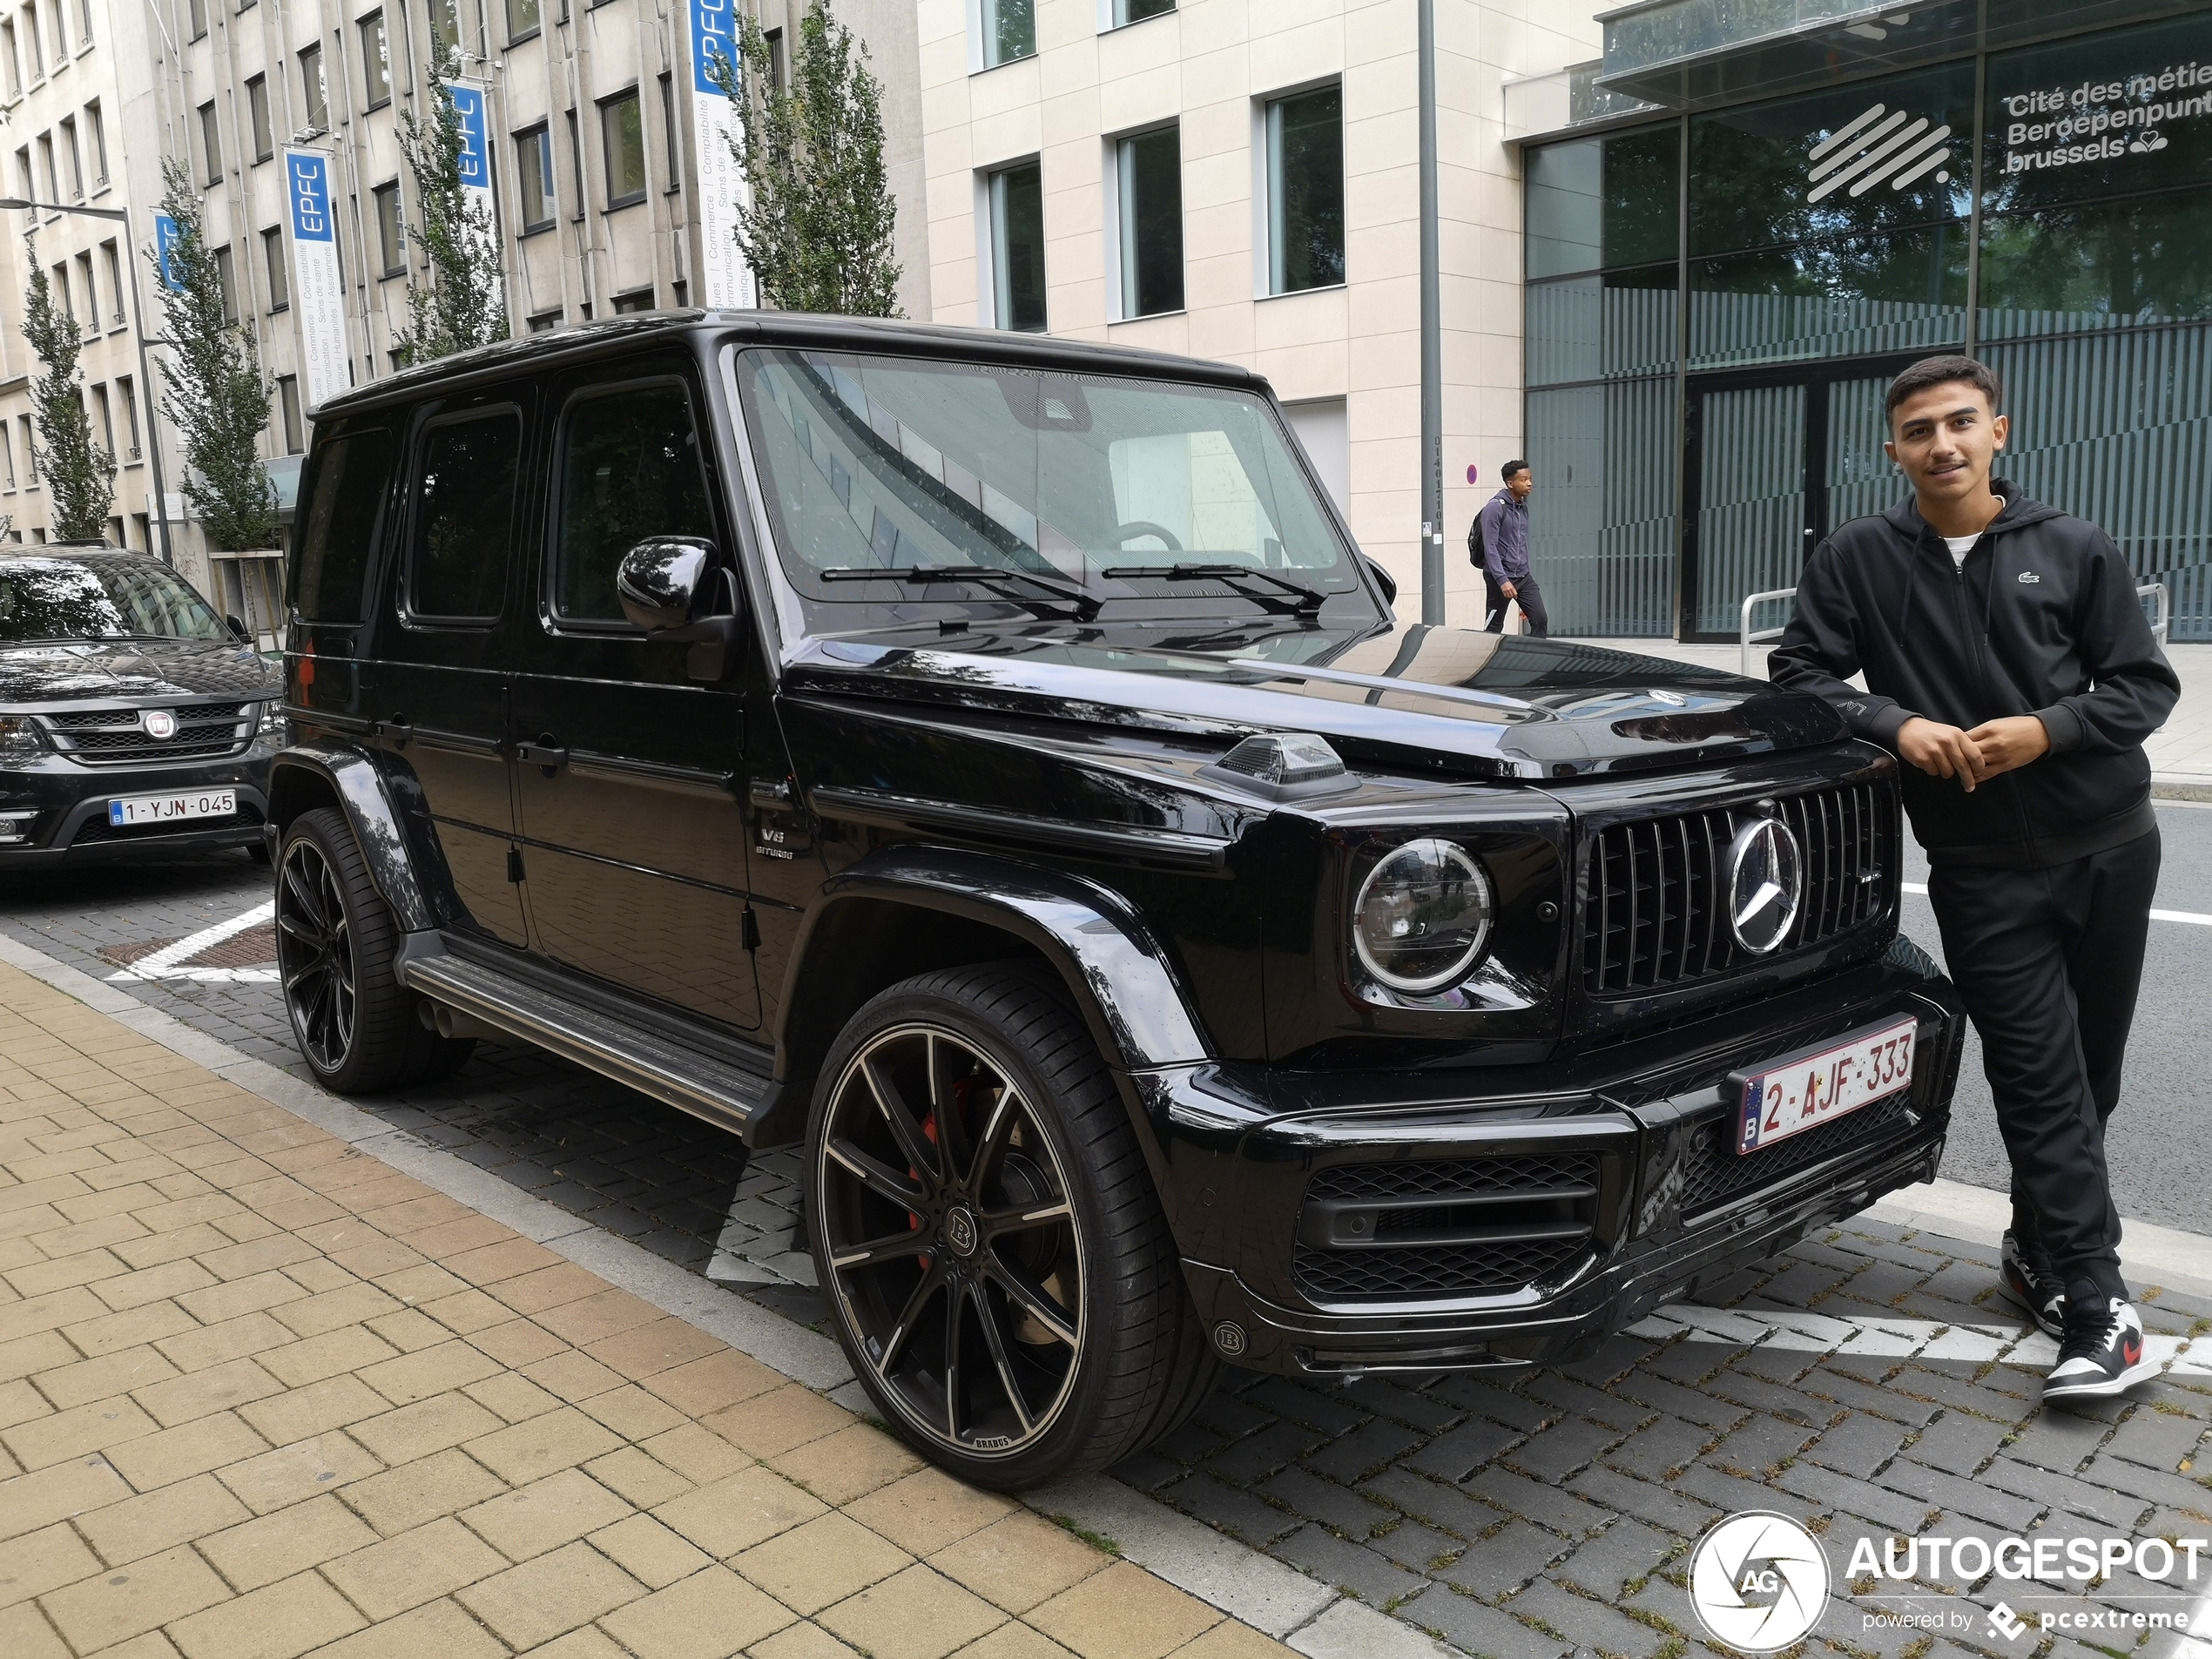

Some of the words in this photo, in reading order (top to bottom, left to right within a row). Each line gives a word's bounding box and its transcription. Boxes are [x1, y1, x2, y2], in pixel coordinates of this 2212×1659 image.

[2009, 86, 2065, 117] Cité
[2071, 82, 2123, 106] des
[2007, 91, 2212, 145] Beroepenpunt
[699, 100, 711, 174] Comptabilité
[2000, 136, 2125, 174] .brussels
[717, 158, 725, 172] de
[296, 163, 323, 232] EPFC
[718, 176, 727, 208] Soins
[707, 196, 718, 260] Commerce
[299, 245, 311, 300] Comptabilité
[313, 259, 321, 283] santé
[325, 246, 335, 297] Assurances
[315, 286, 323, 297] de
[318, 299, 327, 323] Soins
[307, 314, 319, 361] Commerce
[331, 308, 341, 354] Humanités
[151, 718, 169, 732] FIAT
[113, 814, 122, 823] B
[1764, 1033, 1912, 1133] 2-AJF-333
[1744, 1117, 1757, 1141] B
[975, 1437, 1009, 1448] BRABUS
